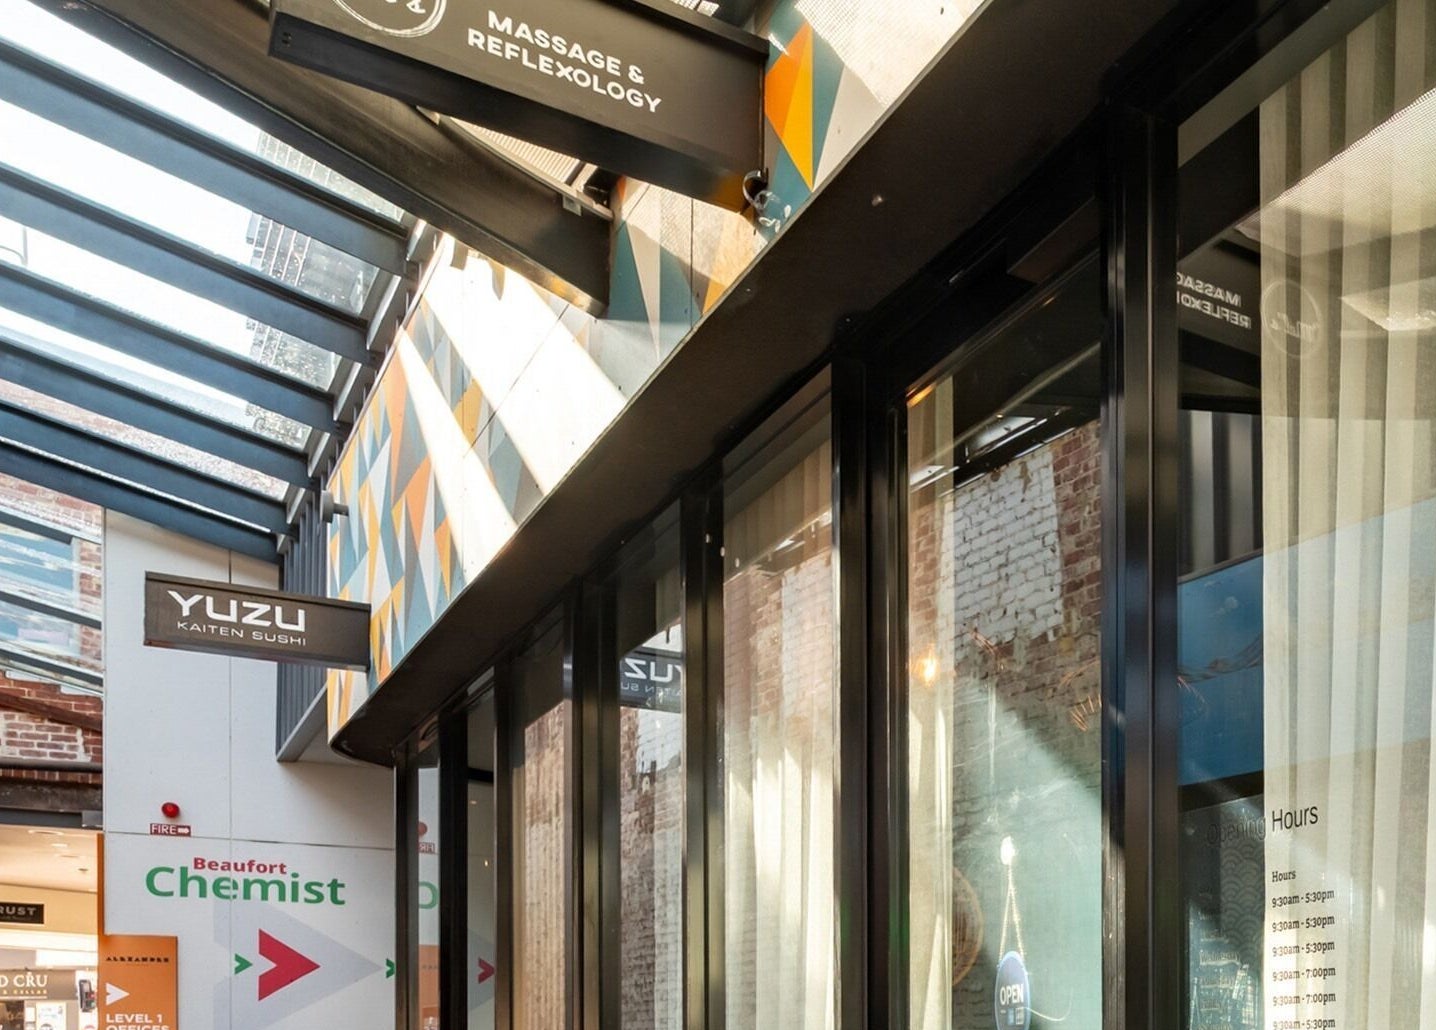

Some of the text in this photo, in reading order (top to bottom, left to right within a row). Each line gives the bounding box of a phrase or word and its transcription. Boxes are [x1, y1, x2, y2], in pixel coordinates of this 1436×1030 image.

[488, 10, 645, 85] MASSAGE &
[467, 28, 662, 113] REFLEXOLOGY
[168, 590, 305, 632] YUZU
[177, 621, 306, 646] KAITEN SUSHI
[1272, 806, 1318, 832] Hours
[151, 824, 176, 835] FIRE
[193, 857, 287, 875] Beaufort
[1272, 870, 1296, 882] Hours
[145, 866, 345, 905] Chemist
[1272, 894, 1300, 908] 9:30am
[1305, 889, 1335, 904] 5:30pm
[1272, 919, 1300, 932] 9:30am
[1305, 915, 1335, 929] 5:30pm
[1272, 945, 1300, 957] 9:30am
[1305, 941, 1335, 954] 5:30pm
[1272, 970, 1300, 982] 9:30am
[1306, 967, 1336, 980] 7:00pm
[1000, 984, 1024, 1005] OPEN
[1273, 995, 1300, 1007] 9:30am
[1306, 993, 1336, 1005] 7:00pm
[106, 1013, 162, 1024] LEVEL 1
[1306, 1018, 1335, 1030] 5:30pm
